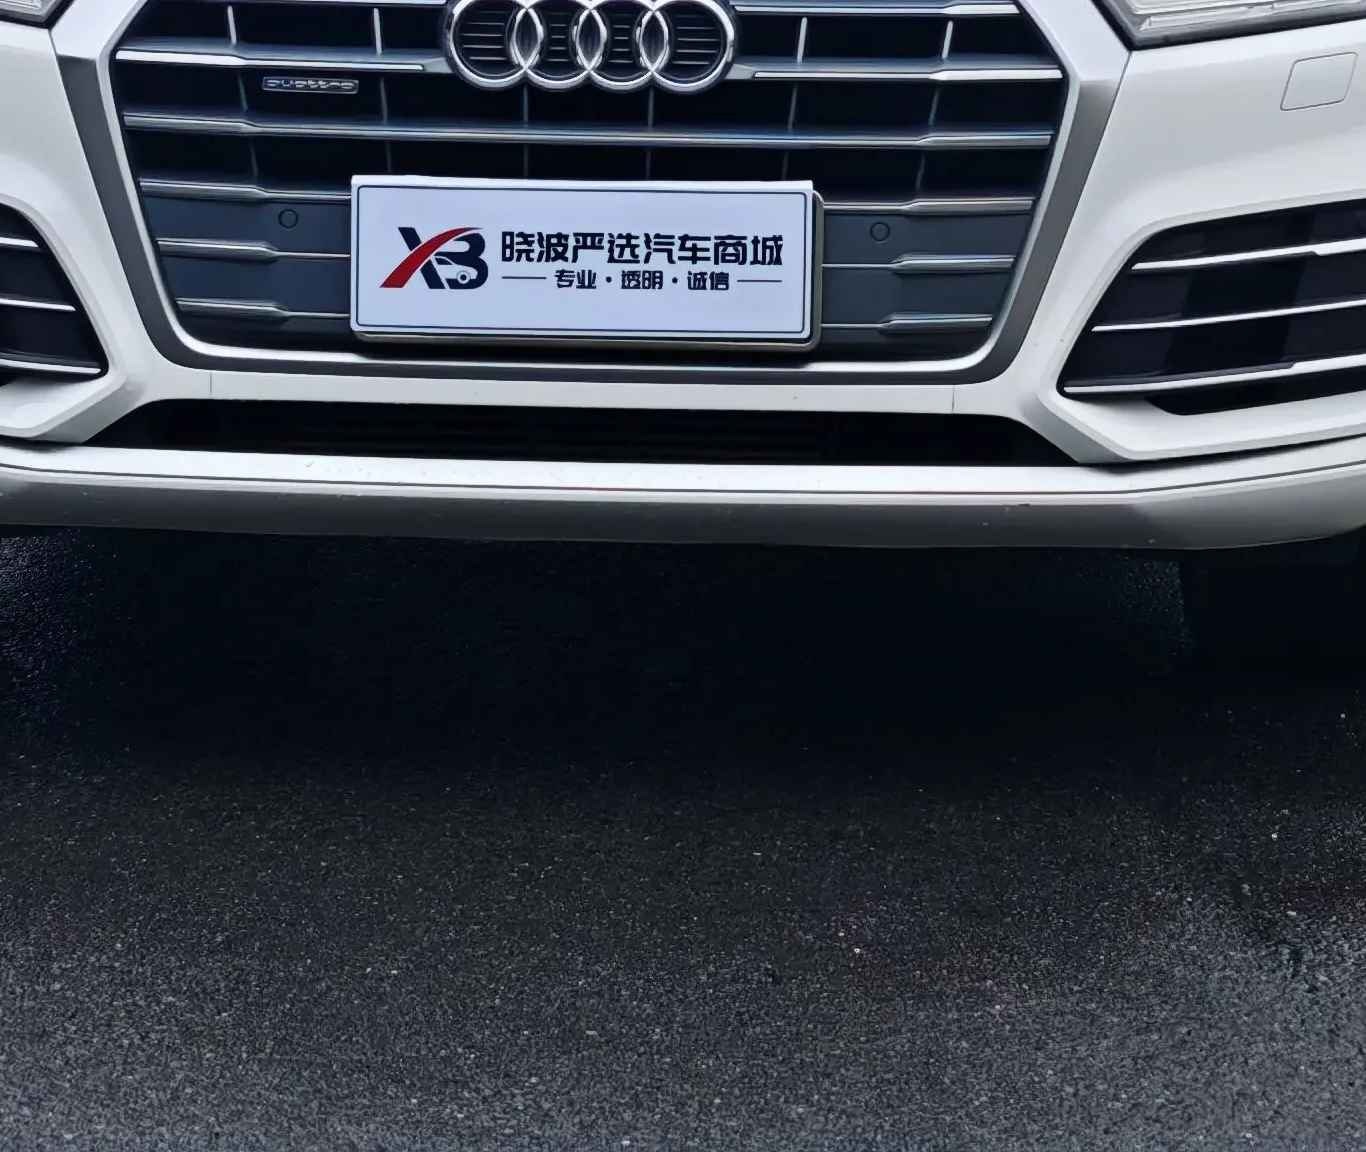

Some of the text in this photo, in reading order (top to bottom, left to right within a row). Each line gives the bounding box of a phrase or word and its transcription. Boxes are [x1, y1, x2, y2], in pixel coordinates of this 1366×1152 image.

[501, 231, 784, 266] 晓波严选汽车商城
